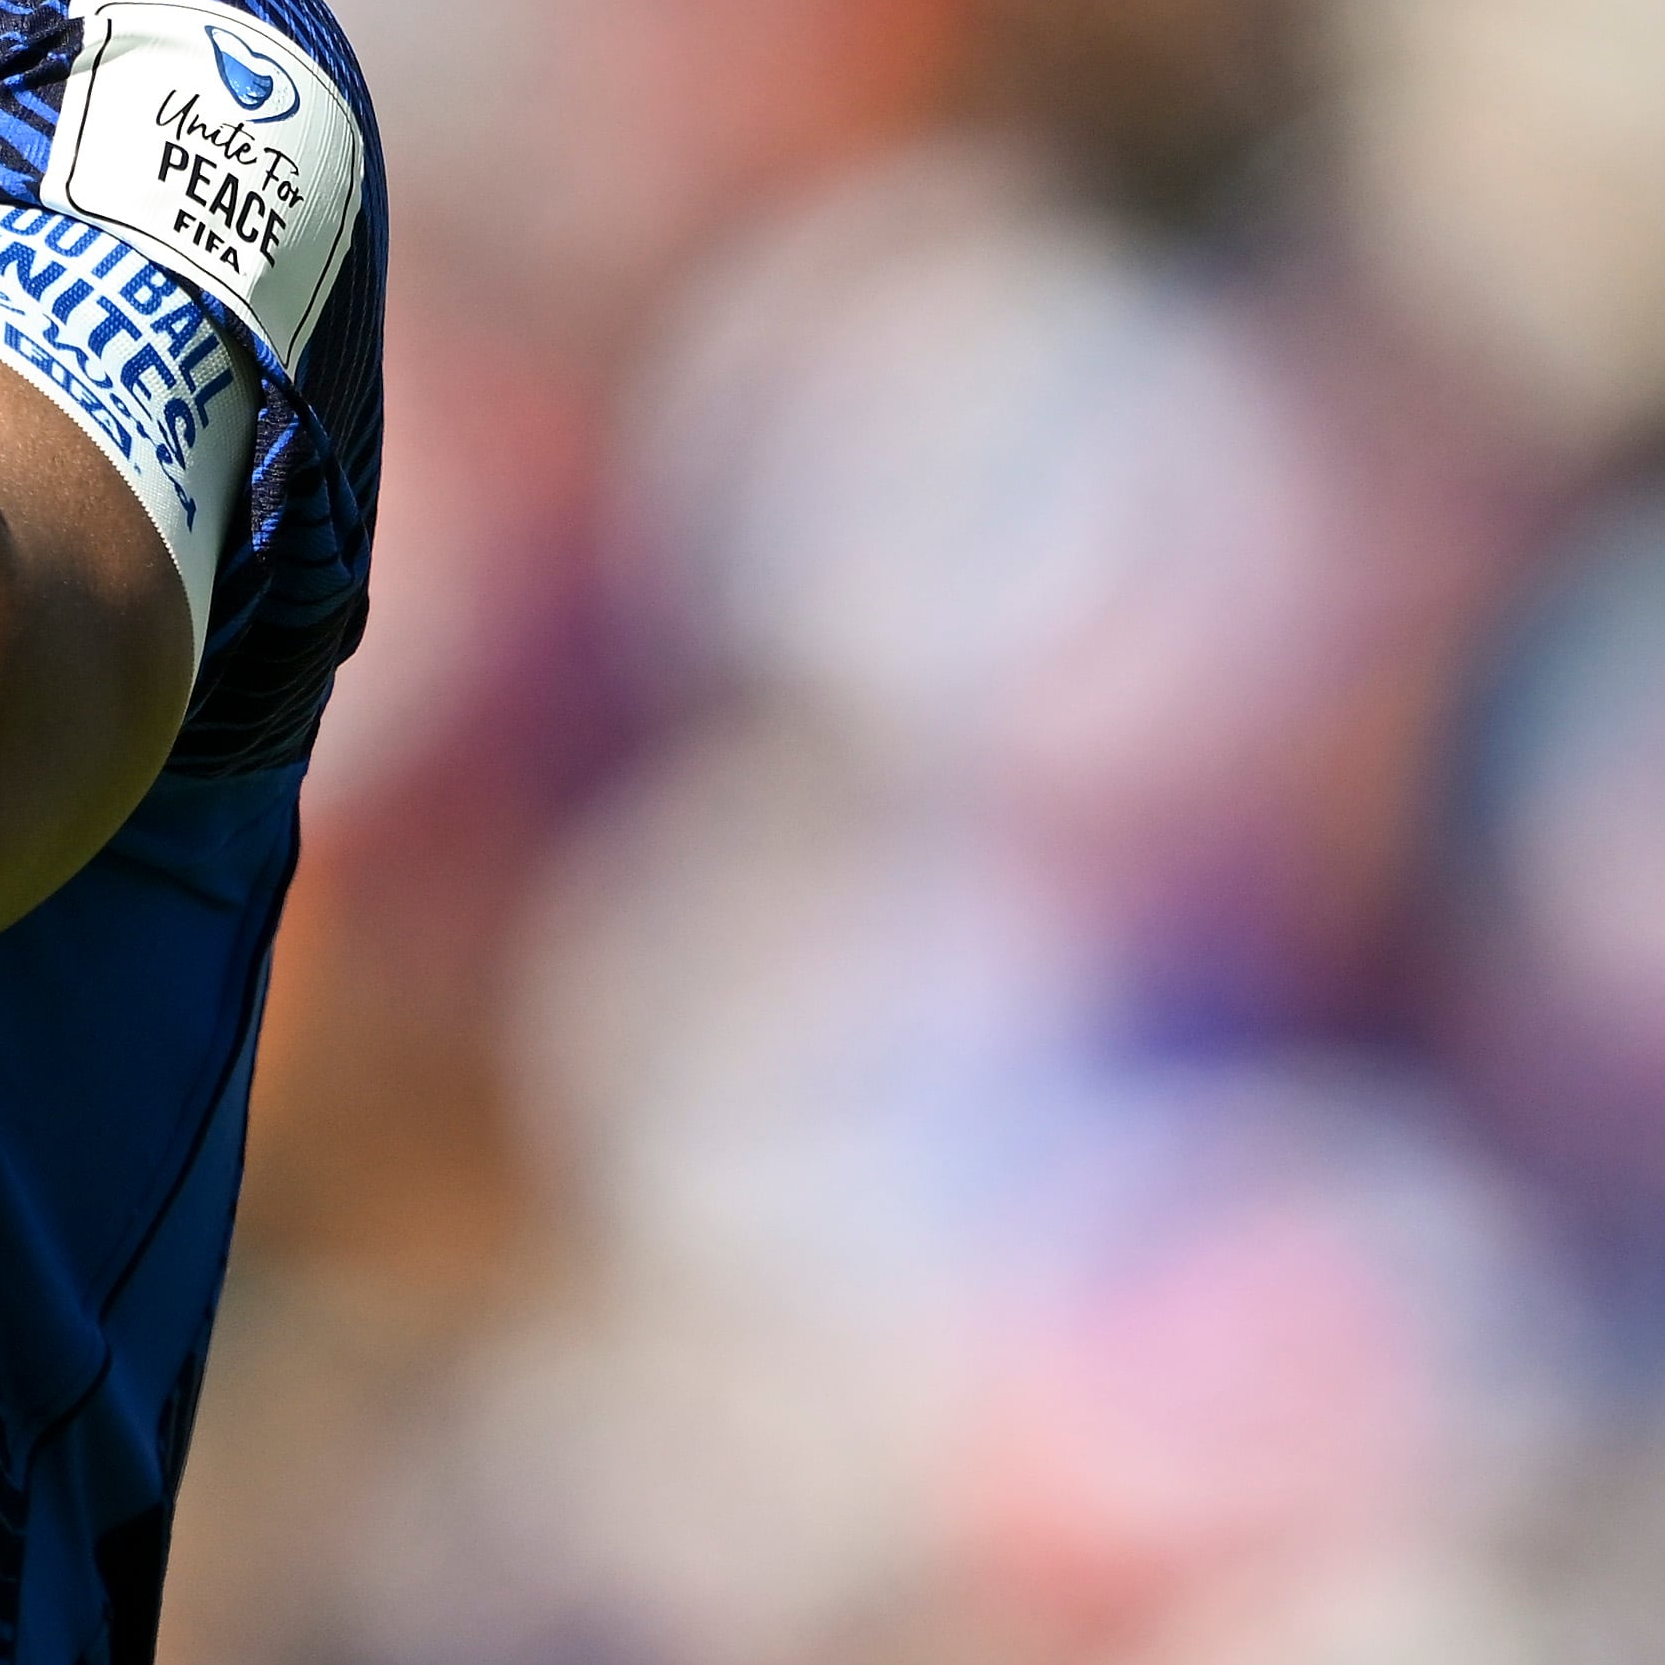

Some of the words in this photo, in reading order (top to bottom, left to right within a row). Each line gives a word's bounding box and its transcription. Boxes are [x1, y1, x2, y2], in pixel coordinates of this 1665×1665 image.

[156, 89, 257, 164] Unite
[262, 147, 304, 208] For
[158, 141, 286, 268] PEACE
[173, 208, 240, 274] FIFA
[13, 330, 128, 452] FIFA
